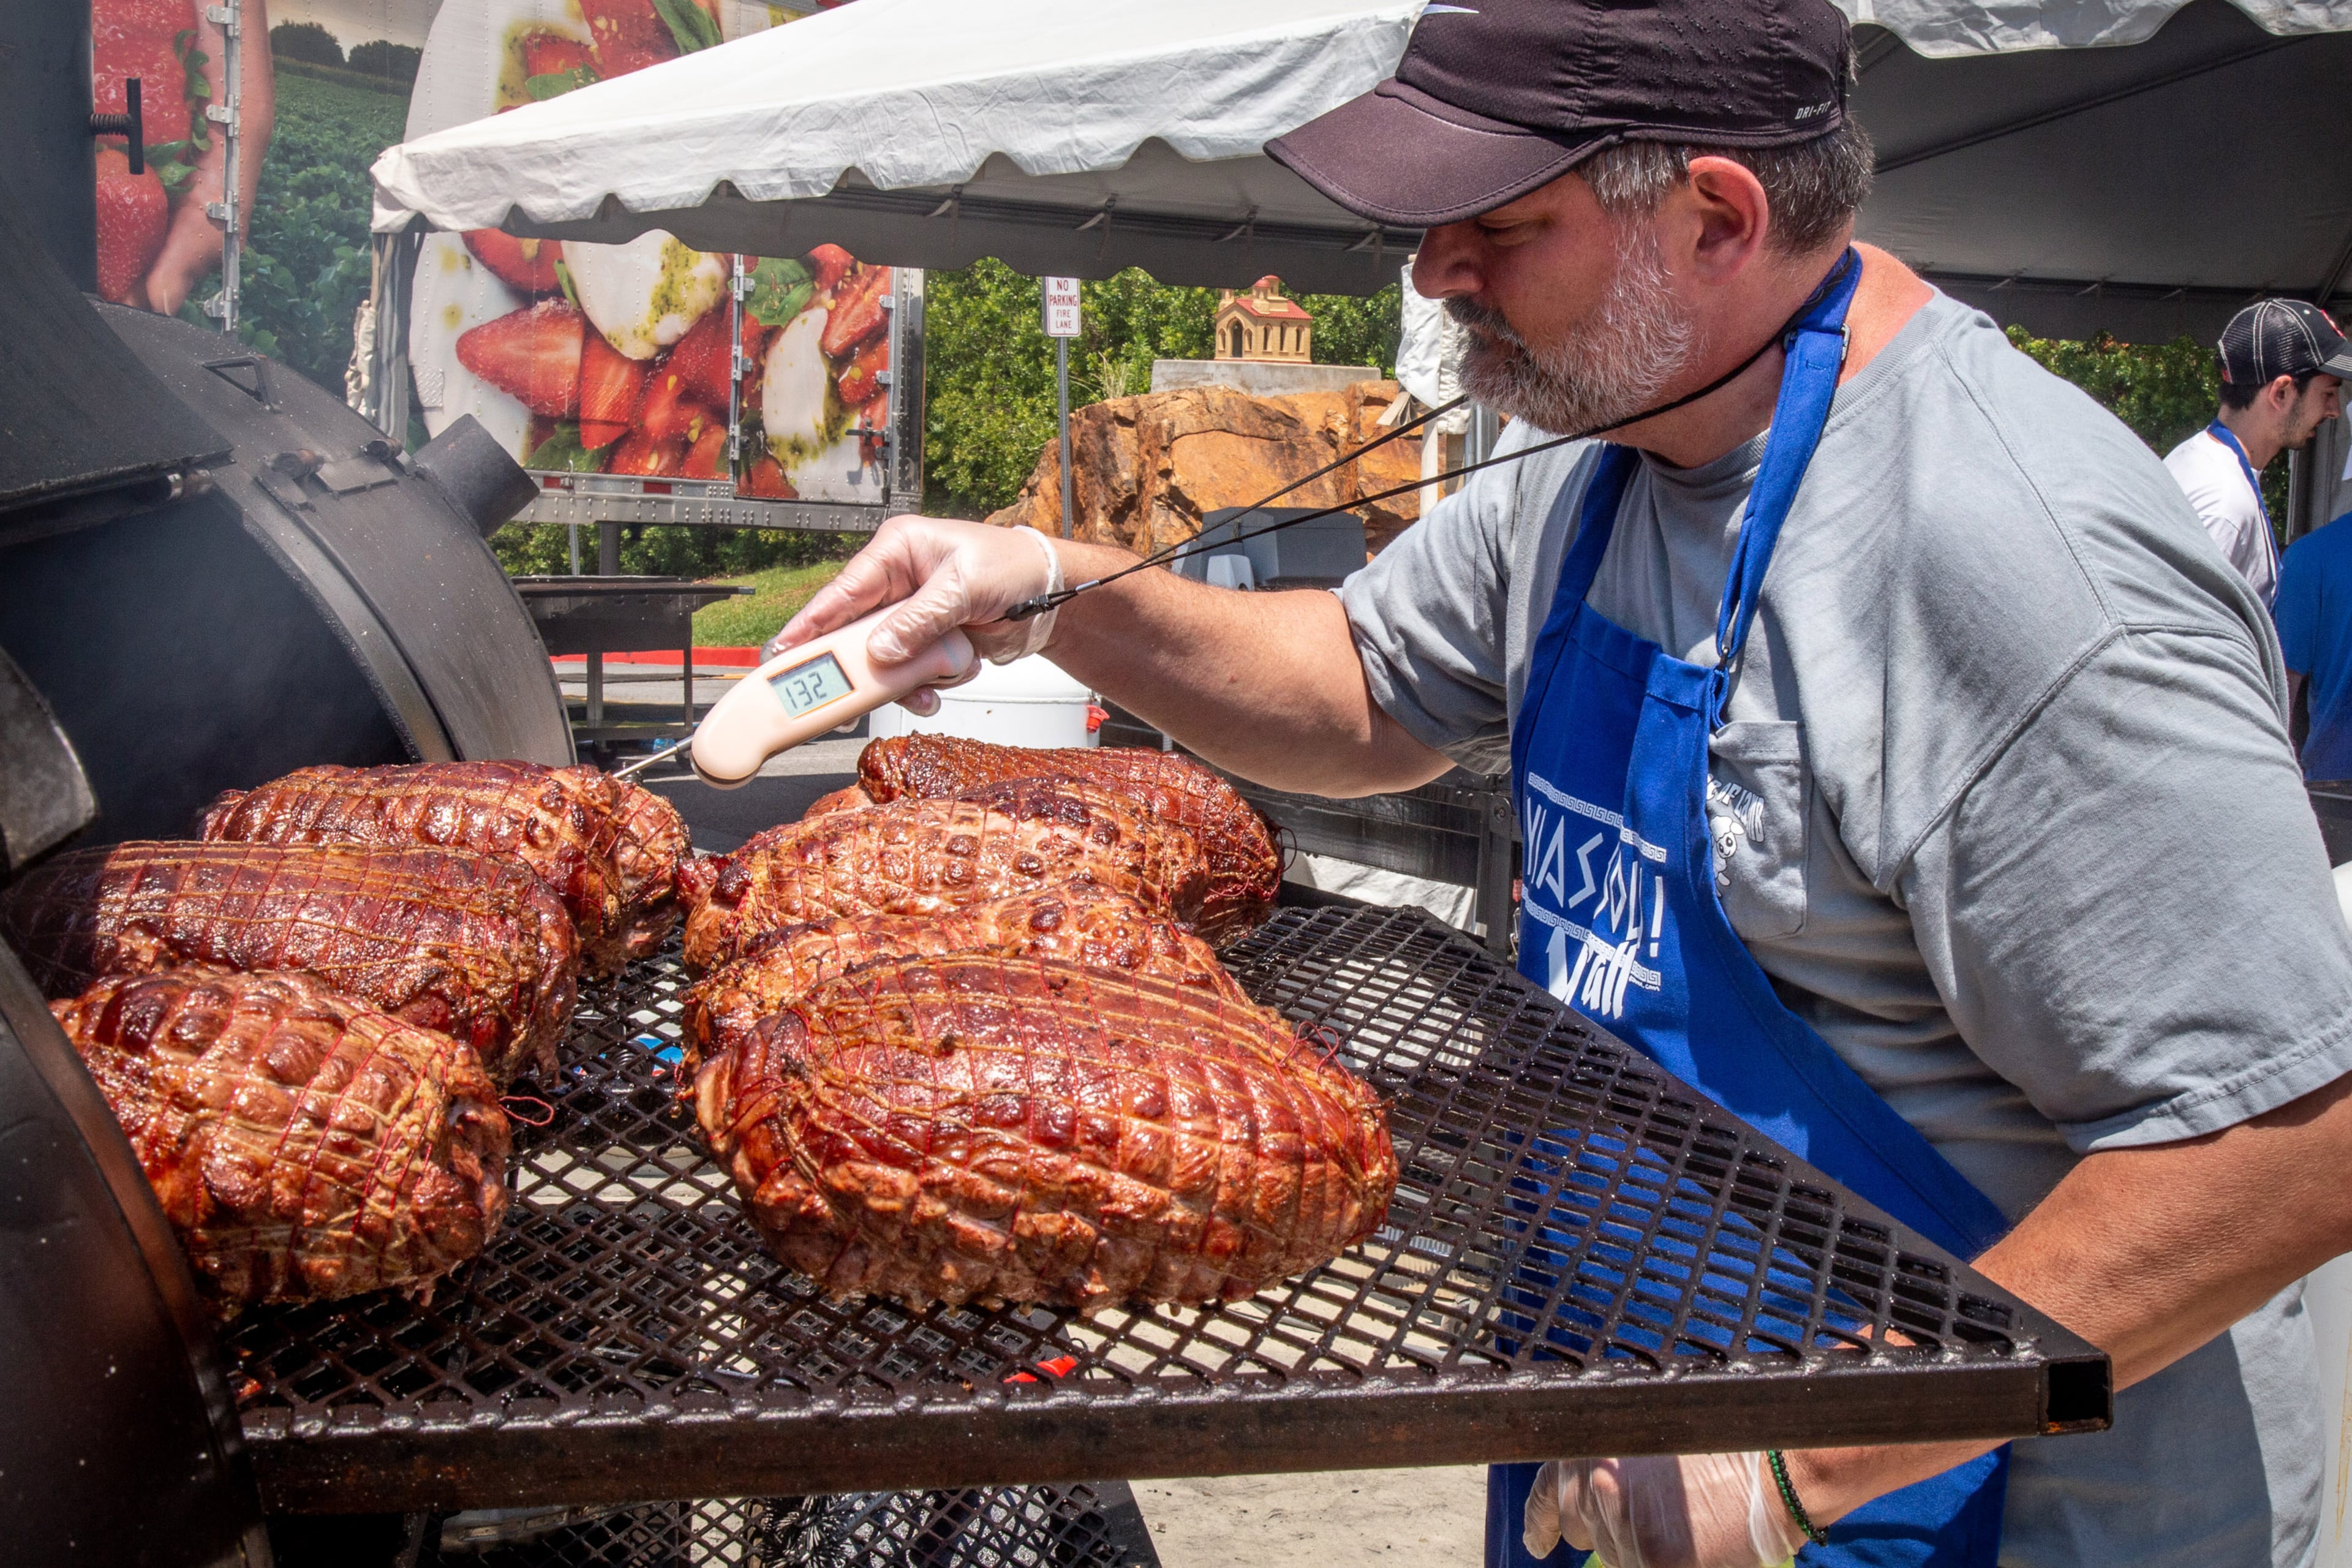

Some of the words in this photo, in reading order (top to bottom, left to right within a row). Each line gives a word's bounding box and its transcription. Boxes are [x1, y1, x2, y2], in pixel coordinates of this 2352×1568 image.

[1794, 100, 1831, 119] DRI-FIT
[1057, 280, 1069, 291] NO
[1049, 295, 1077, 306] PARKING
[1056, 309, 1071, 318] FIRE
[1055, 320, 1072, 329] LANE
[785, 671, 827, 709] 132
